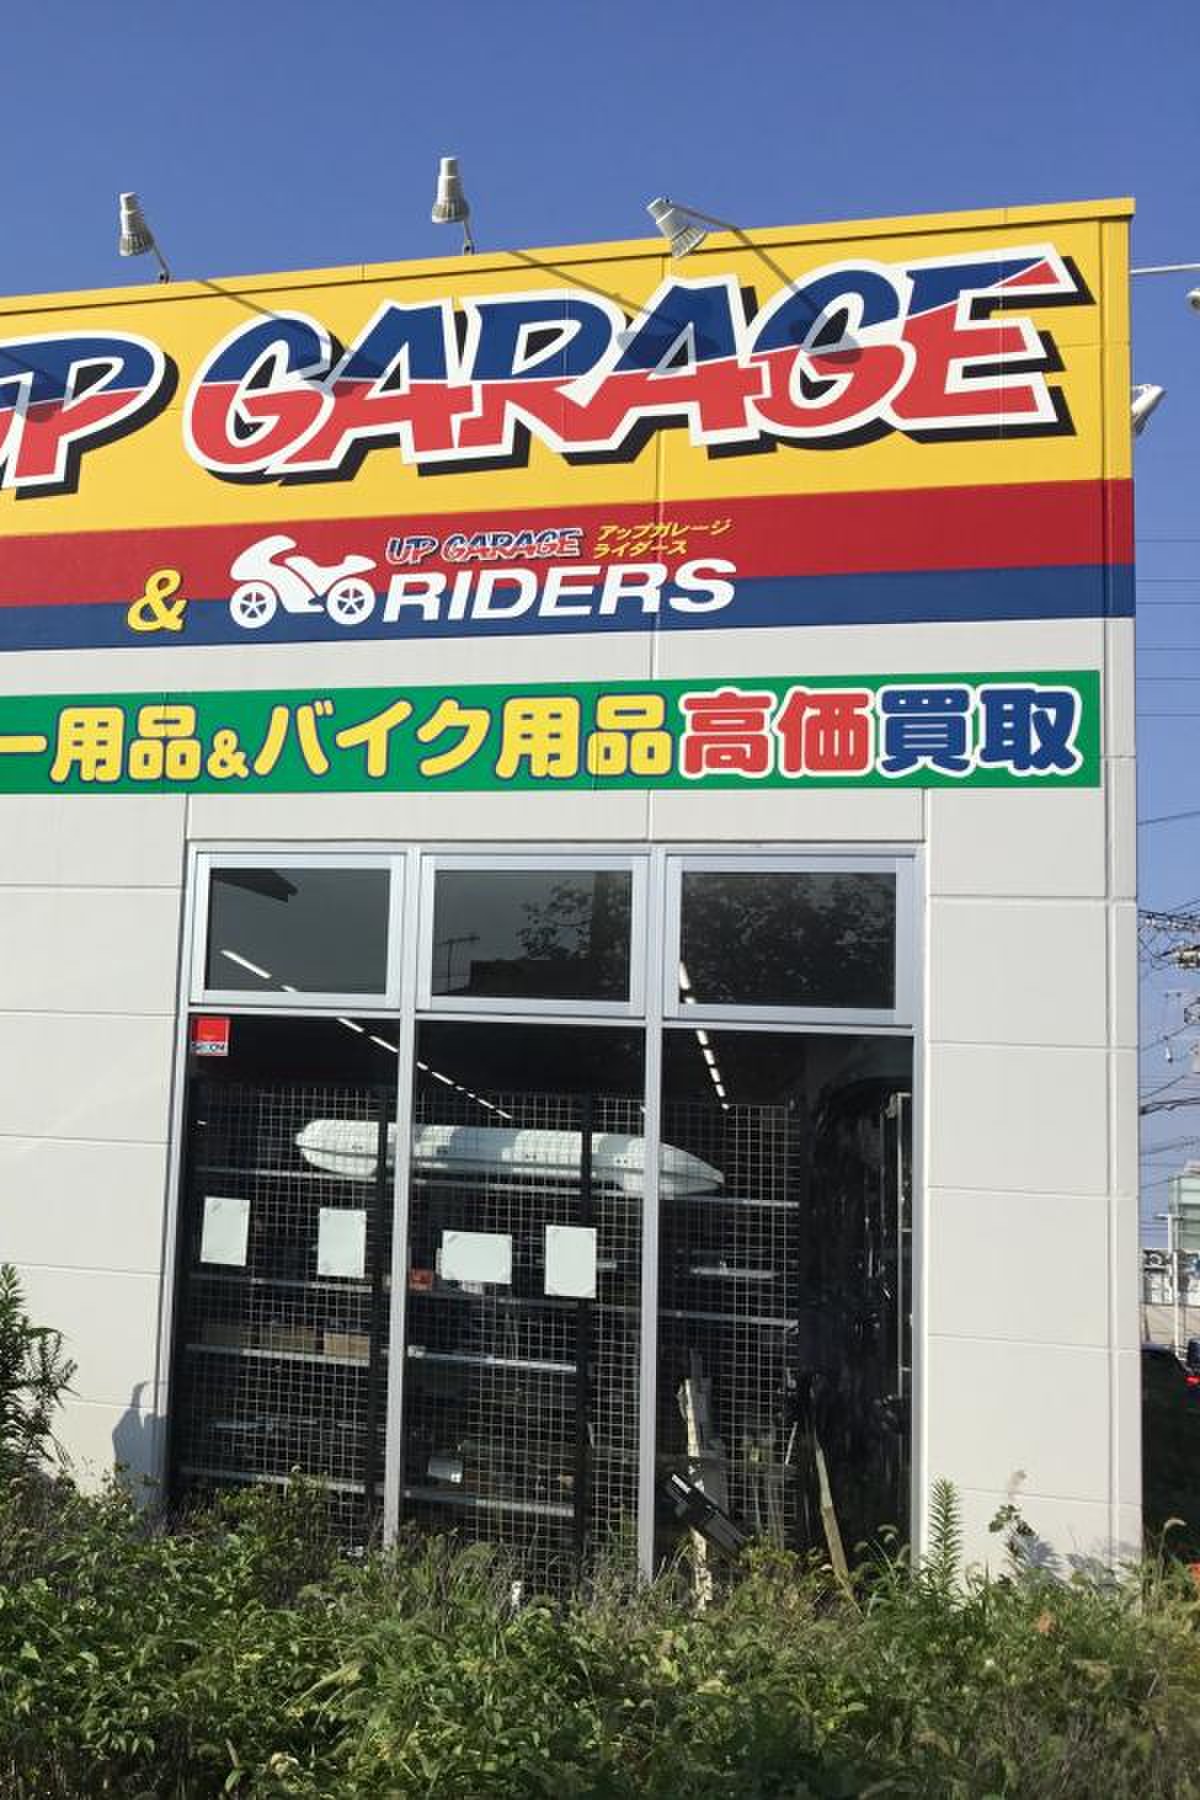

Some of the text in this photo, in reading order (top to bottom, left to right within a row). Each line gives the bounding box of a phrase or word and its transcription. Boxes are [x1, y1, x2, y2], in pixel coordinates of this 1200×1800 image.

[182, 242, 1088, 484] GARAGE
[385, 527, 583, 565] UP GARAGE
[597, 518, 733, 541] アップガレージ
[593, 540, 688, 559] ライダース
[126, 558, 737, 633] & RIDERS
